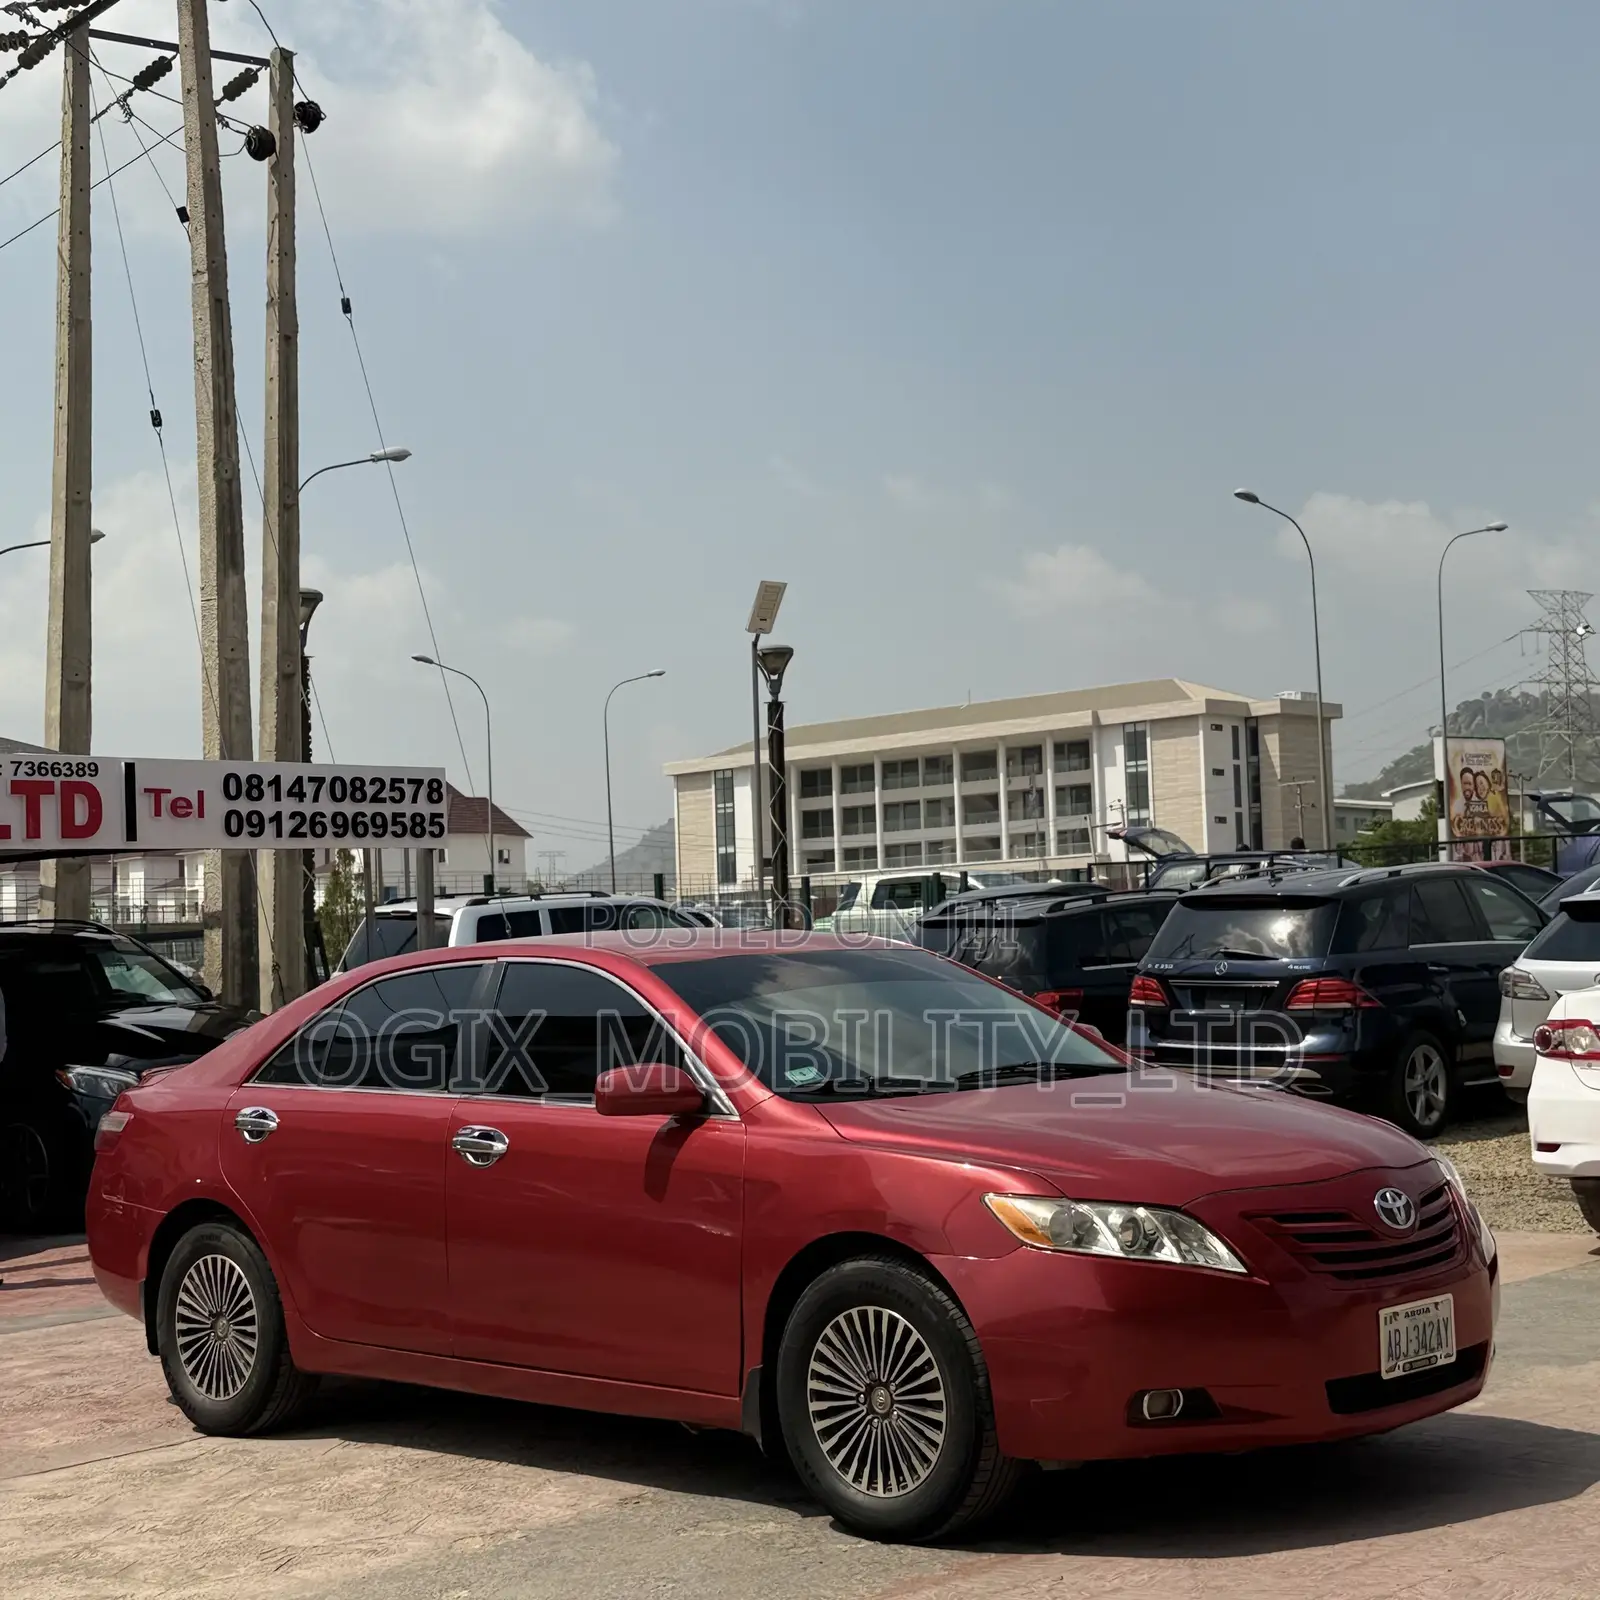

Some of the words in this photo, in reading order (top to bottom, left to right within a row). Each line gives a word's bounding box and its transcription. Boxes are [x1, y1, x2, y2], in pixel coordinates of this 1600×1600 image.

[10, 761, 99, 777] 7366389
[143, 787, 205, 819] Tel
[222, 773, 444, 805] 08147082578
[224, 809, 446, 839] 09126969585
